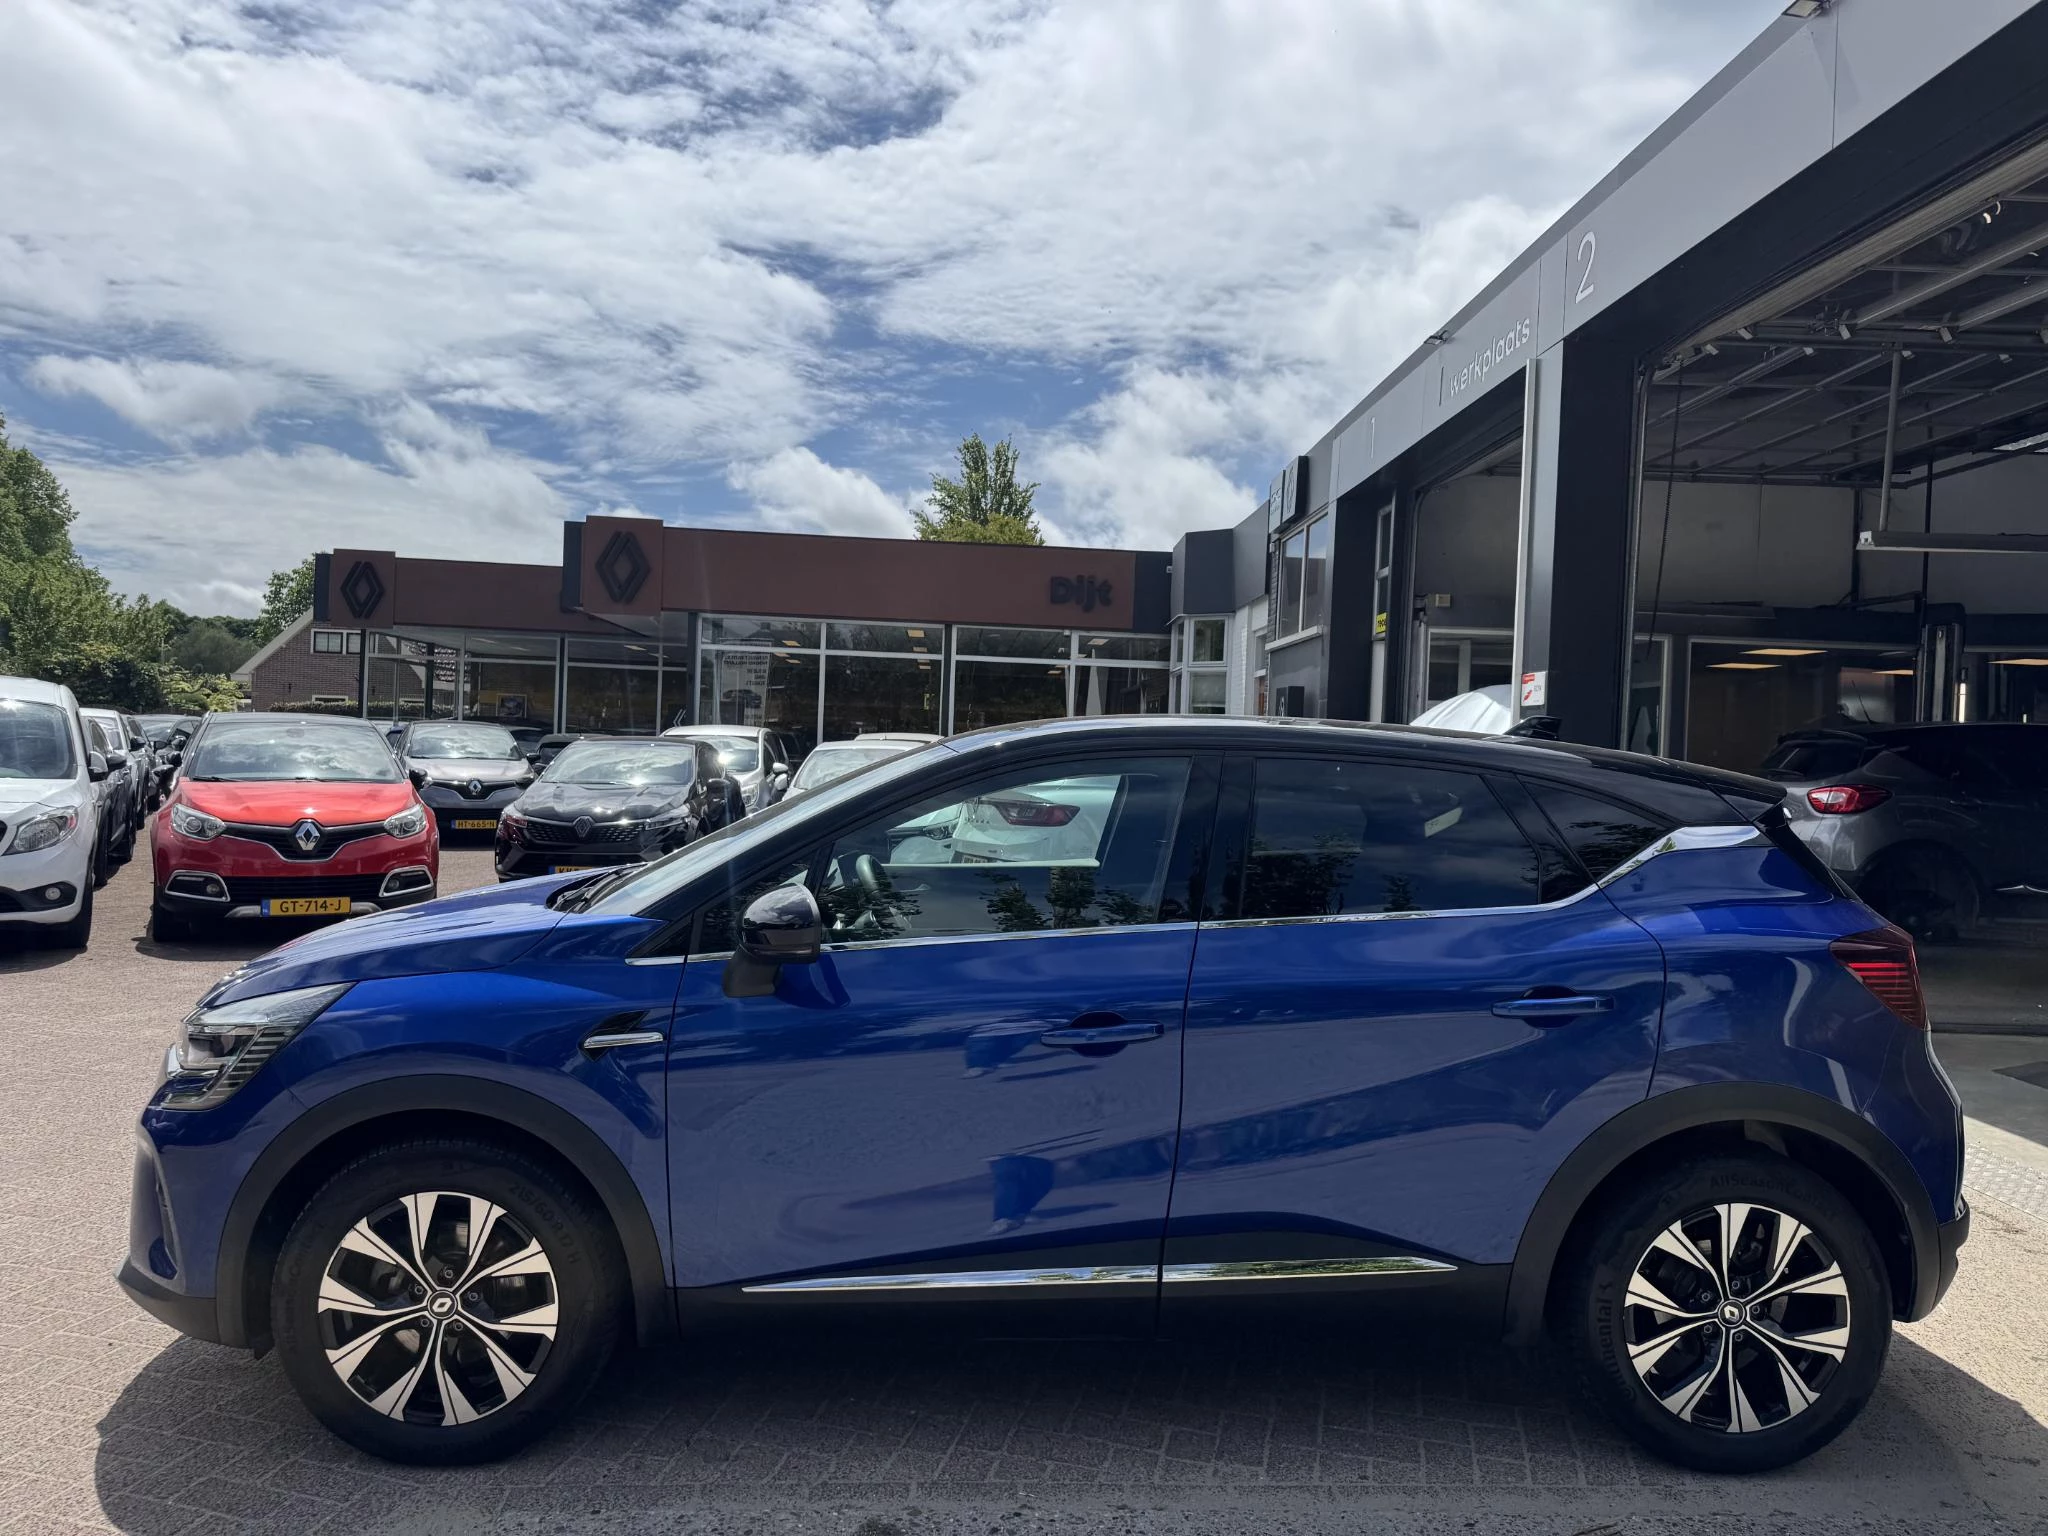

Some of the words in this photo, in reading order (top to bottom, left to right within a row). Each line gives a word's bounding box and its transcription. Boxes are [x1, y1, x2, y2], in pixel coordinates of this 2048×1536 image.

[1575, 231, 1596, 304] 2
[1450, 318, 1529, 397] werkplaats
[1369, 417, 1376, 459] 1
[1050, 575, 1113, 613] Dijt
[457, 820, 495, 828] HT-665-N
[279, 899, 342, 913] GT-714-J
